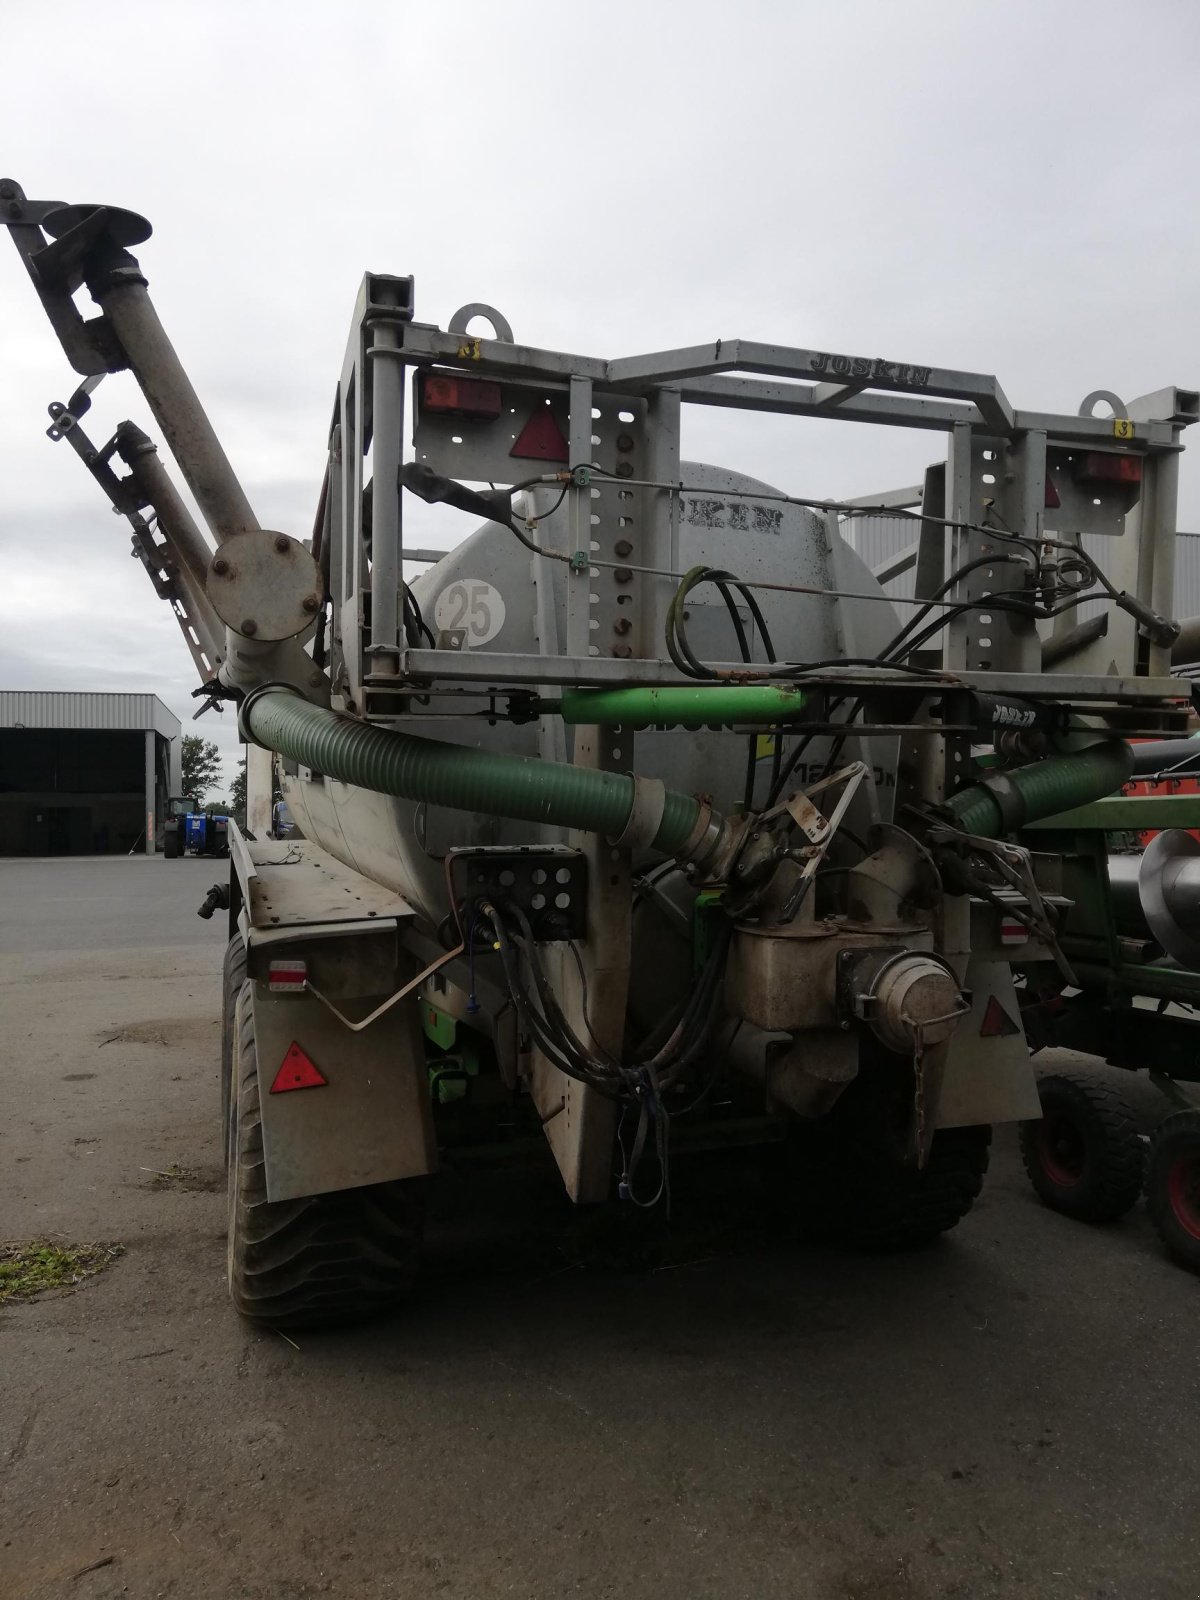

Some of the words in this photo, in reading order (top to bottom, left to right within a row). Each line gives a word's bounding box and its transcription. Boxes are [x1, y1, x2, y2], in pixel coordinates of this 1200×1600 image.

[810, 353, 932, 386] JOSKIN
[680, 499, 784, 535] KIN
[449, 585, 491, 637] 25
